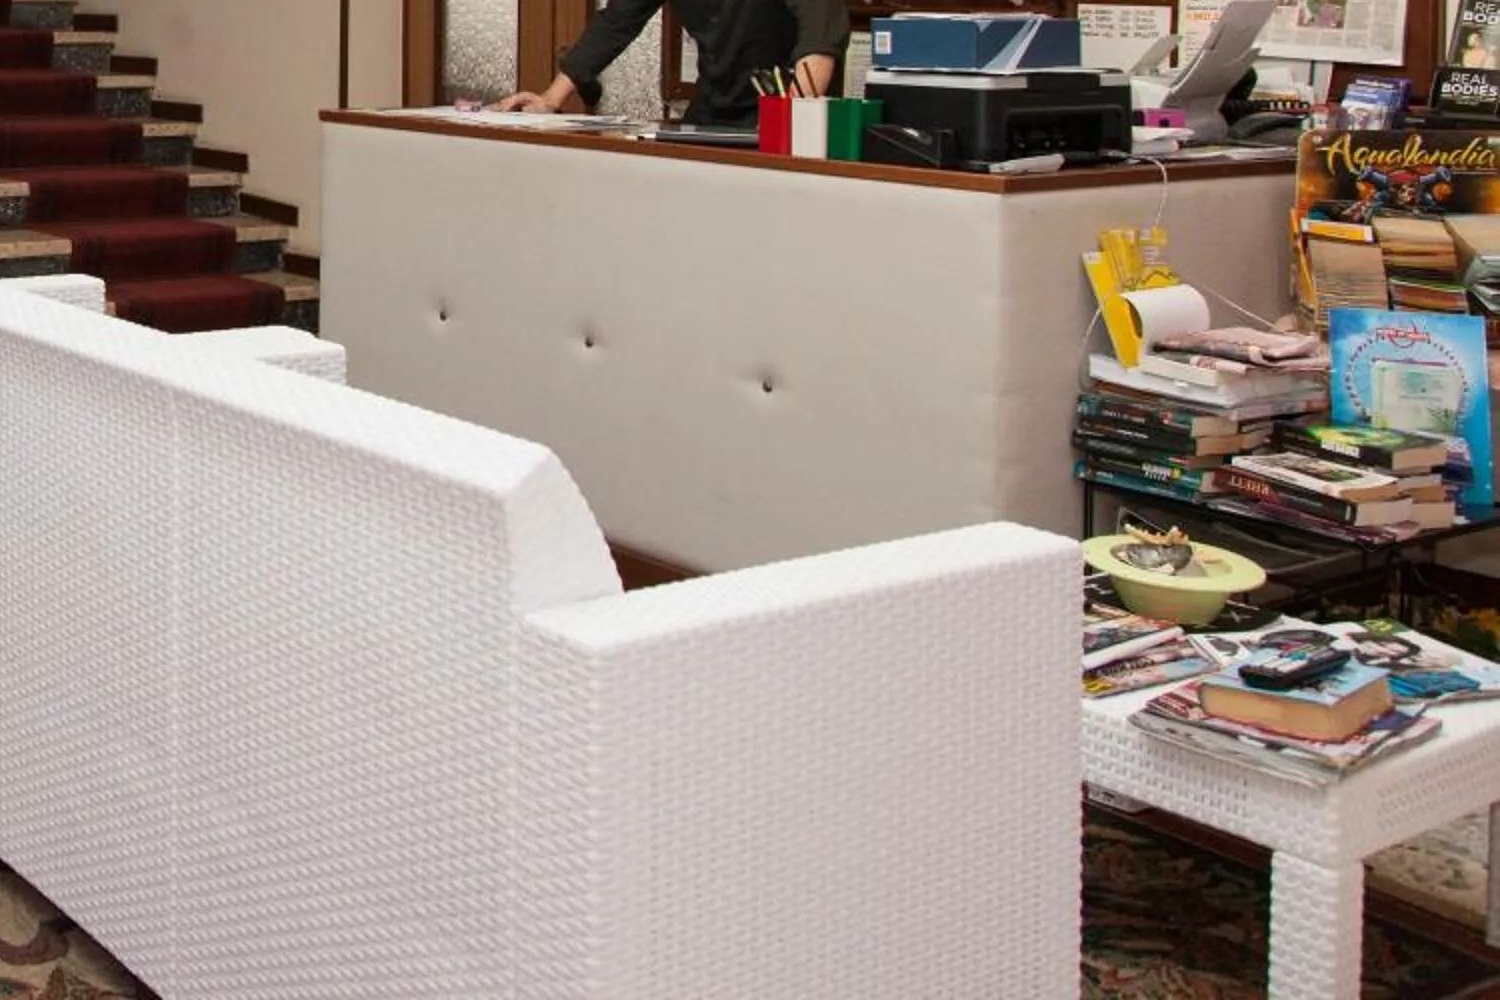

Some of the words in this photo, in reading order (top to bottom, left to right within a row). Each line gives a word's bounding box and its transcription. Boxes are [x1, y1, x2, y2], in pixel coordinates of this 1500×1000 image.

[1474, 1, 1500, 14] RE
[1451, 71, 1487, 85] REAL
[1441, 83, 1499, 96] BODIES
[1316, 132, 1496, 176] Aqualandia
